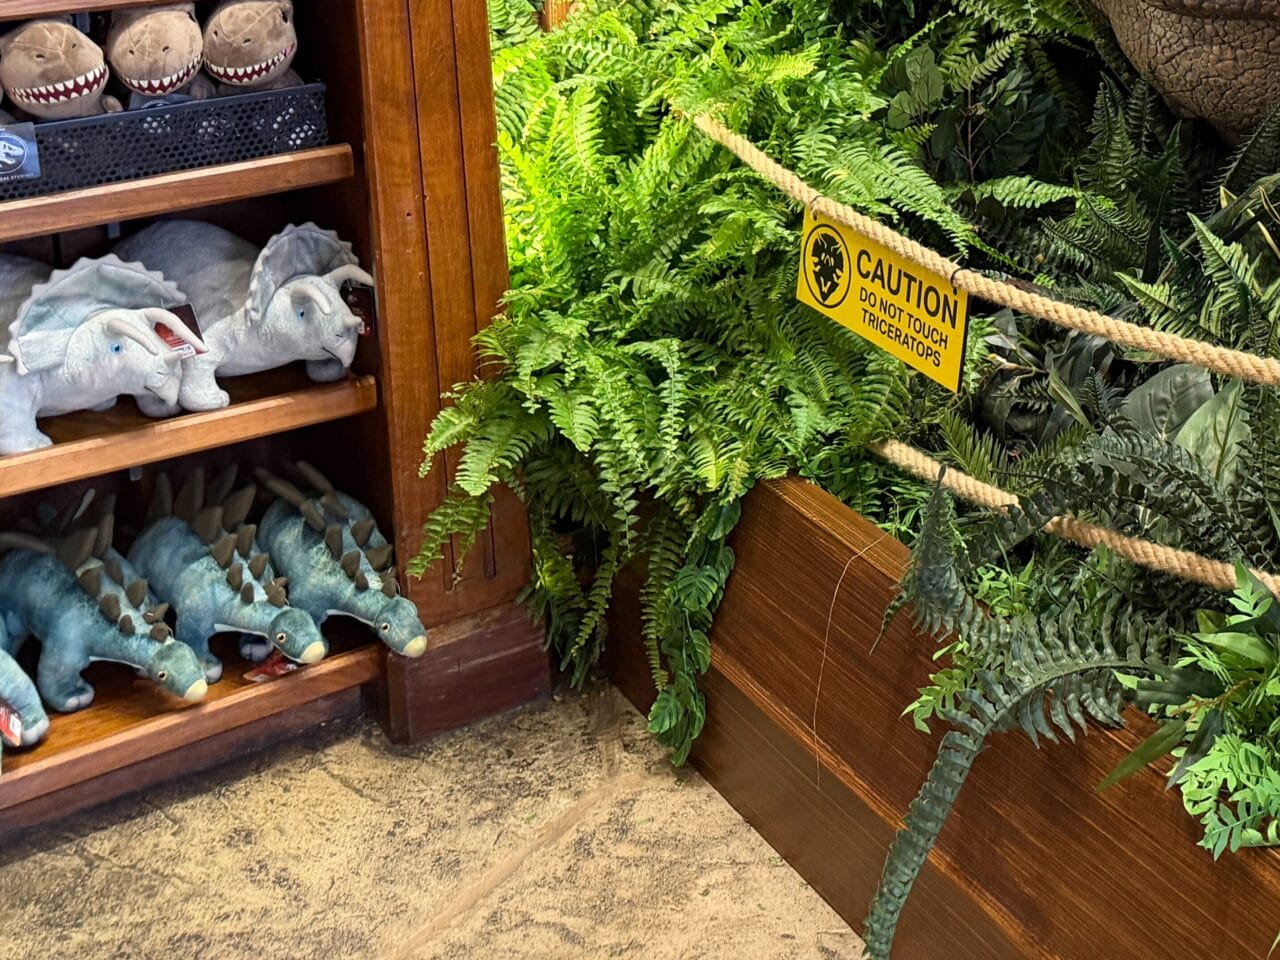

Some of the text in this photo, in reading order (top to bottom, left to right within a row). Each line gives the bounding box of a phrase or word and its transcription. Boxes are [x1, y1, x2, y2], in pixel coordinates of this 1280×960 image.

[856, 249, 959, 330] CAUTION
[859, 286, 948, 350] DO NOT TOUCH
[861, 307, 941, 368] TRICERATOPS
